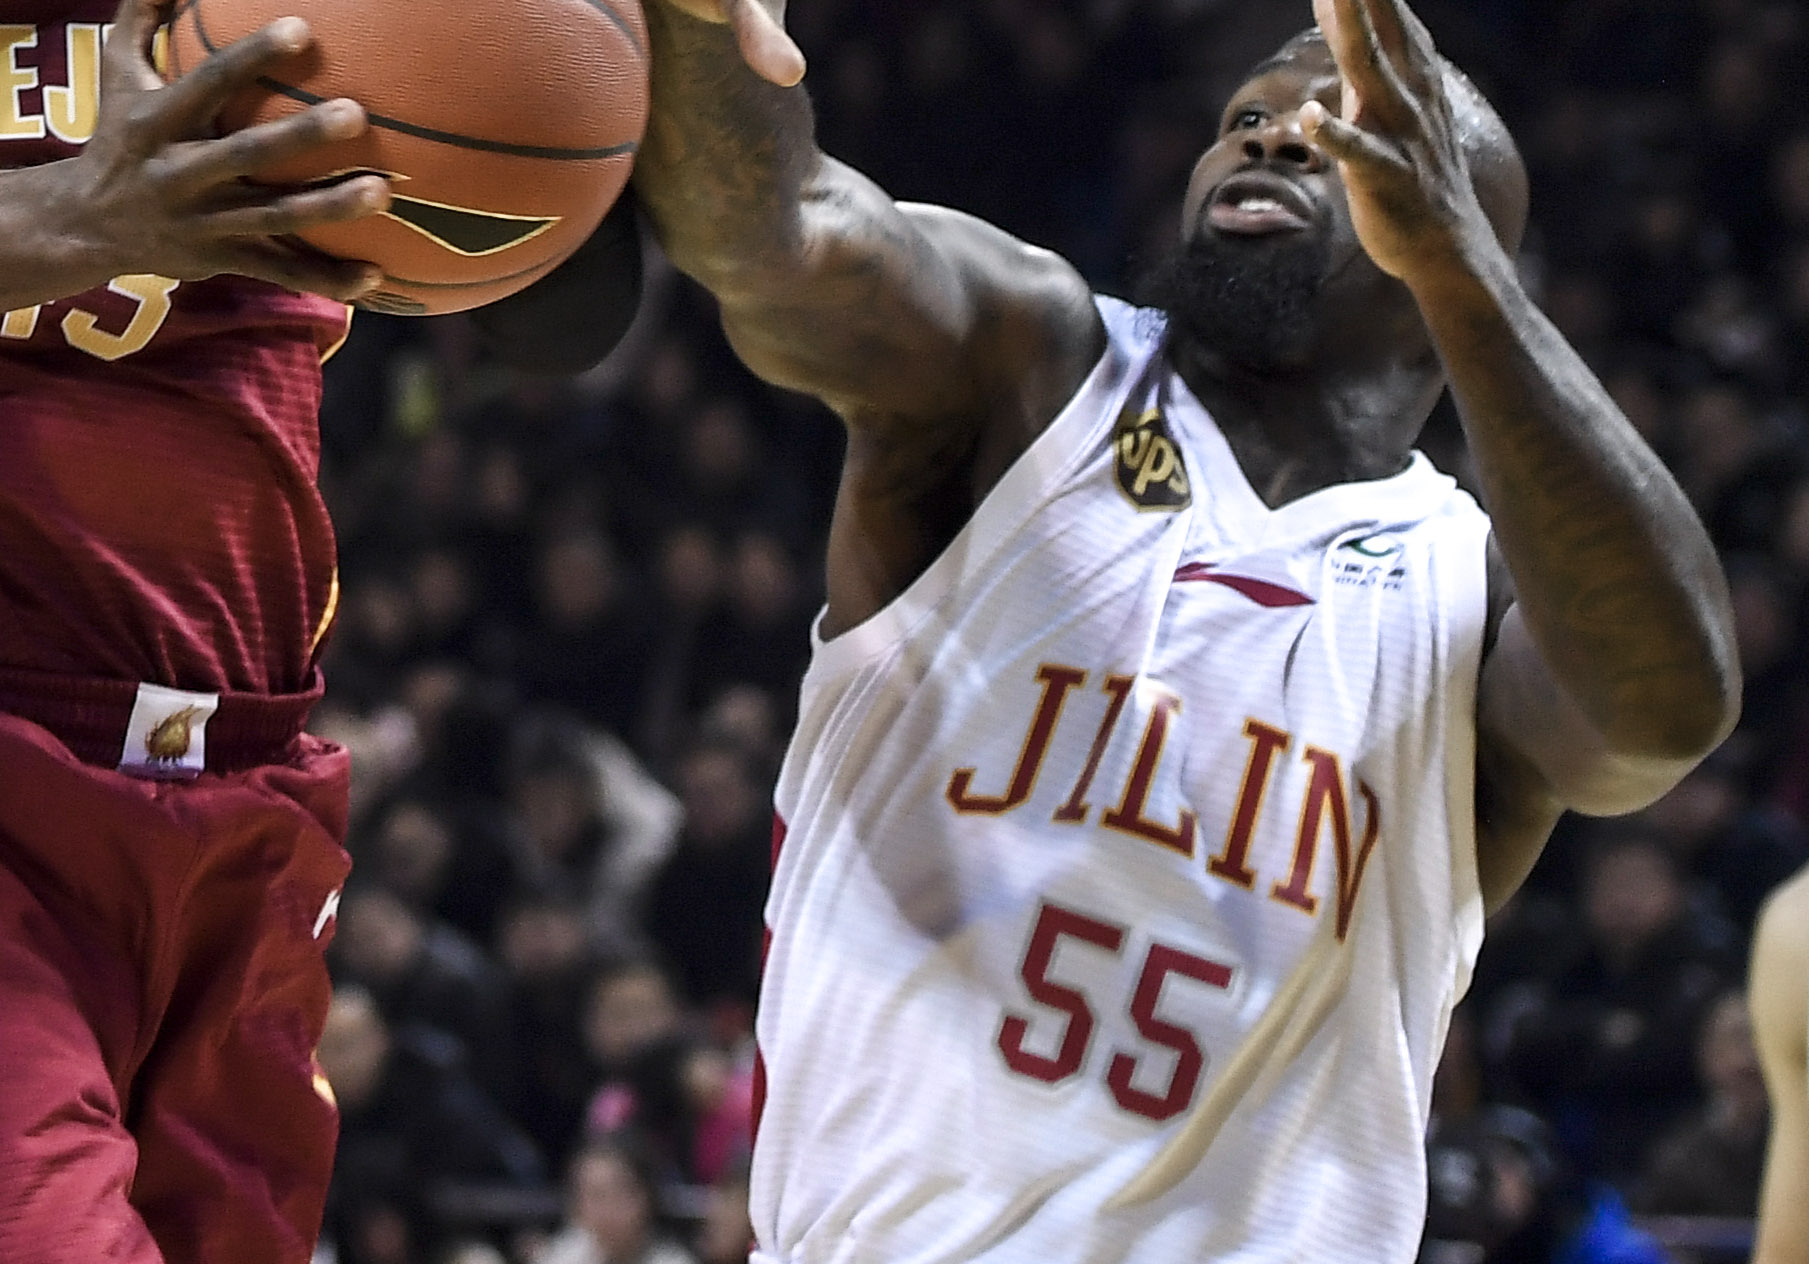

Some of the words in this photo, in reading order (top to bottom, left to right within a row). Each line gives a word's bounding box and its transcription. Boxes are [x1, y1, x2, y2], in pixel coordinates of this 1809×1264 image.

[0, 273, 180, 361] 3
[946, 662, 1380, 942] JILIN
[995, 903, 1234, 1124] 55
